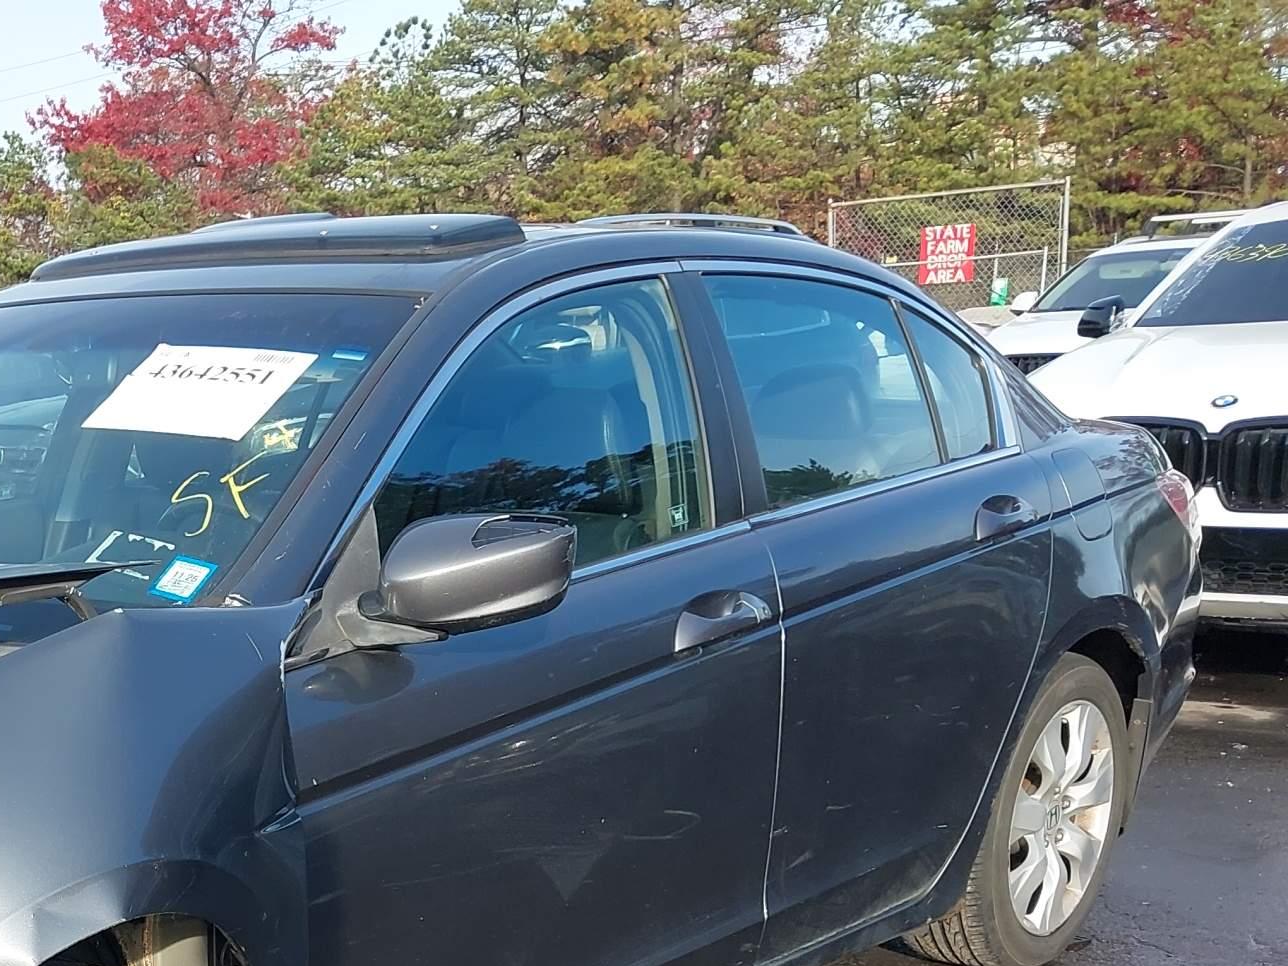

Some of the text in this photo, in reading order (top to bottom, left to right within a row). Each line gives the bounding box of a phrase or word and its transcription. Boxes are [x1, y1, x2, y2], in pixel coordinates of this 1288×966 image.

[925, 224, 971, 240] STATE
[926, 239, 969, 256] FARM
[926, 254, 967, 270] DROP
[925, 268, 966, 284] AREA
[149, 363, 275, 385] 43642551
